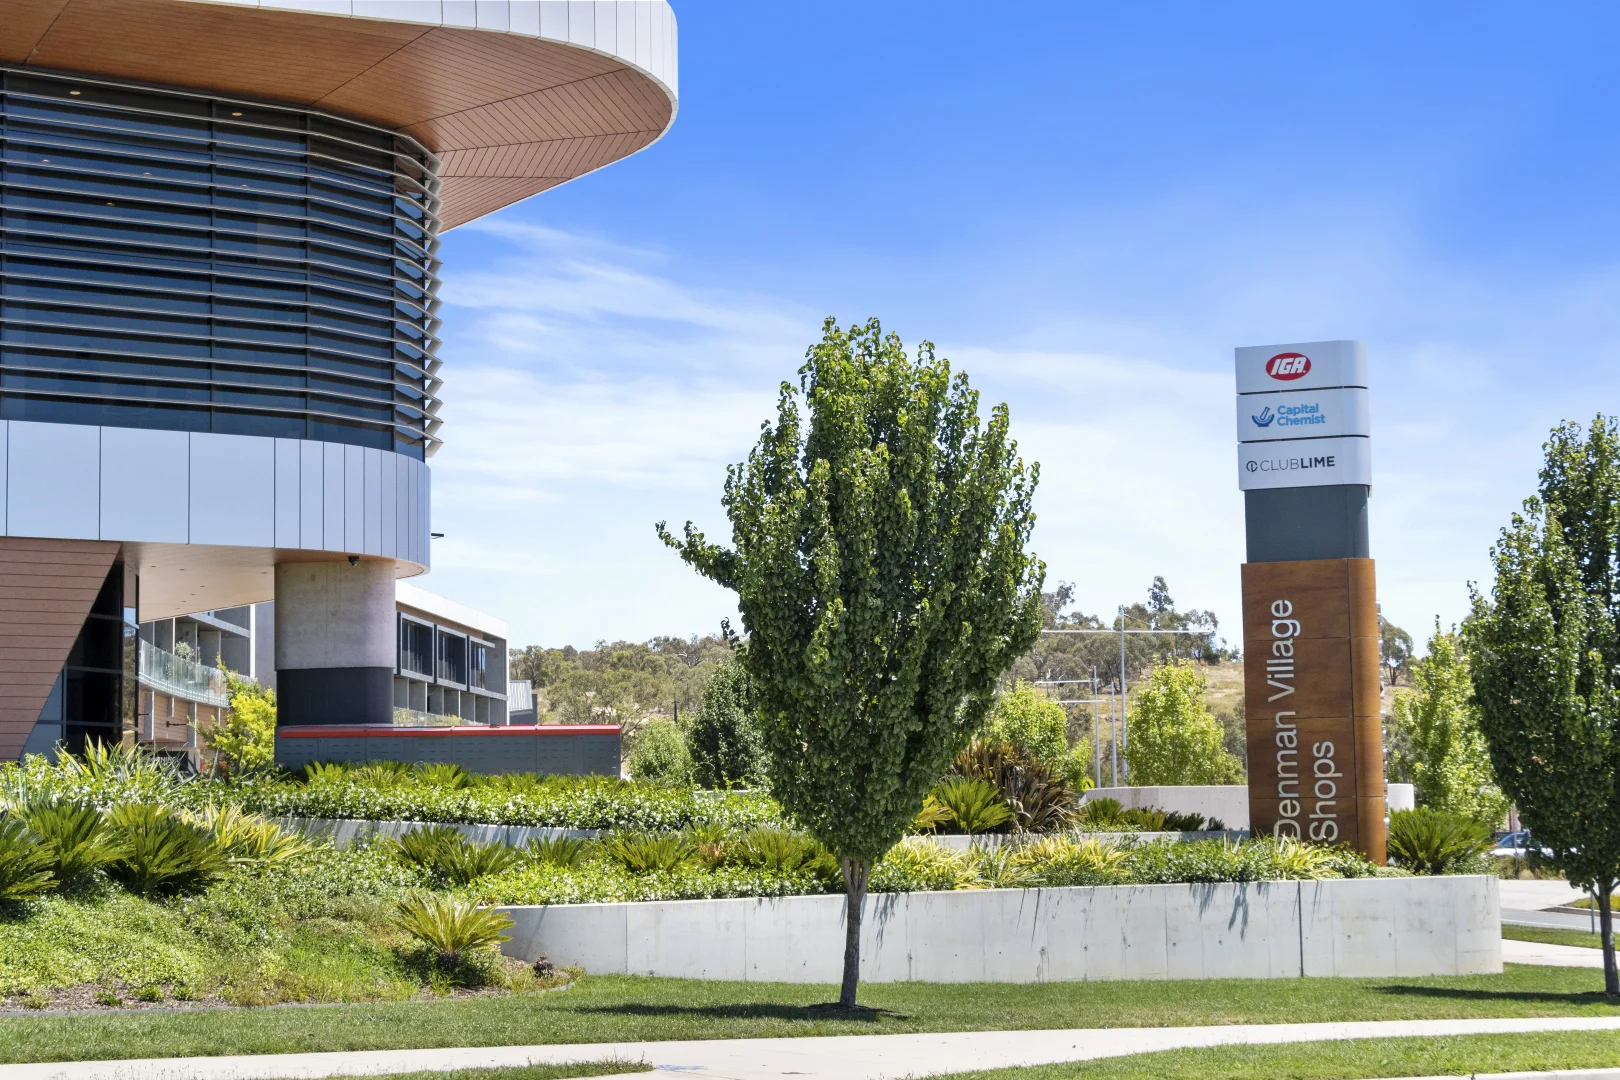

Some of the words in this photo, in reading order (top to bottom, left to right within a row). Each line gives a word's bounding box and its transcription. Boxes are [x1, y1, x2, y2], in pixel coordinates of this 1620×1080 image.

[1270, 357, 1307, 376] IGA
[1277, 403, 1319, 417] Capital
[1277, 414, 1326, 426] Chemist
[1267, 599, 1300, 702] Village
[1273, 711, 1301, 841] Denman
[1309, 741, 1343, 841] Shops
